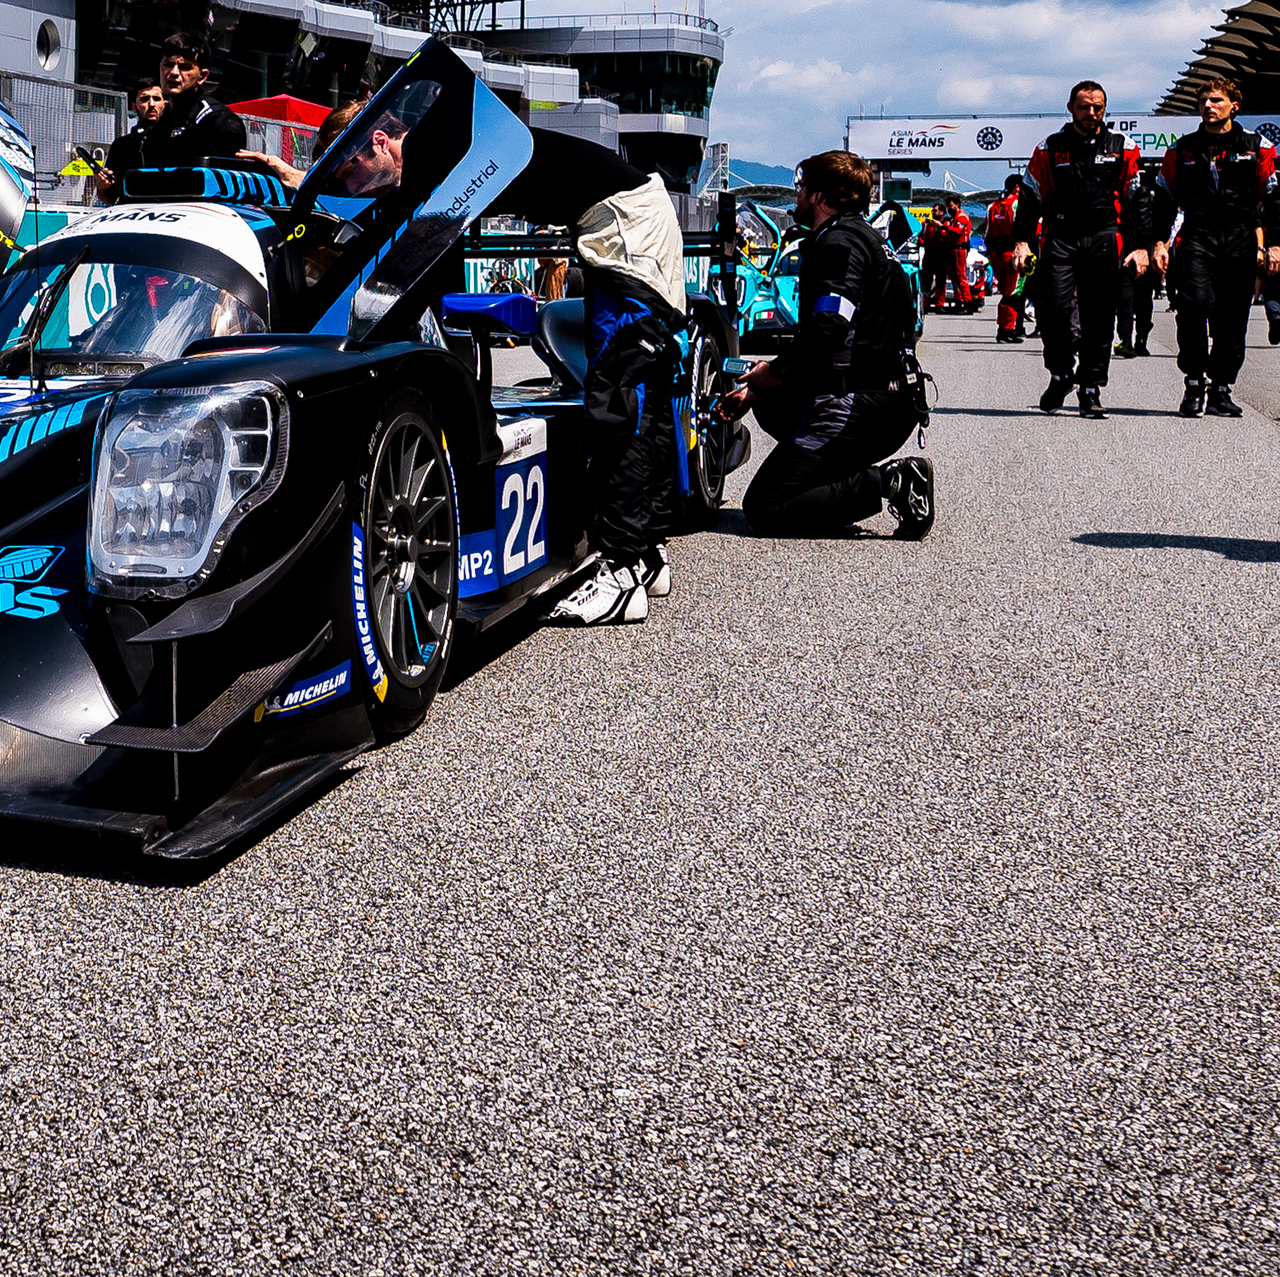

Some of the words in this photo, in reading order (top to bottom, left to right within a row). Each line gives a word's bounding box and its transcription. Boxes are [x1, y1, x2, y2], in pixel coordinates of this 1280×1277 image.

[889, 137, 904, 148] LE
[908, 137, 945, 148] MANS
[1120, 121, 1137, 131] OF
[440, 159, 499, 222] Industrial
[91, 212, 186, 224] MANS
[501, 465, 545, 575] 22
[458, 550, 494, 581] MP2
[353, 536, 376, 665] MICHELIN
[283, 670, 348, 707] MICHELIN
